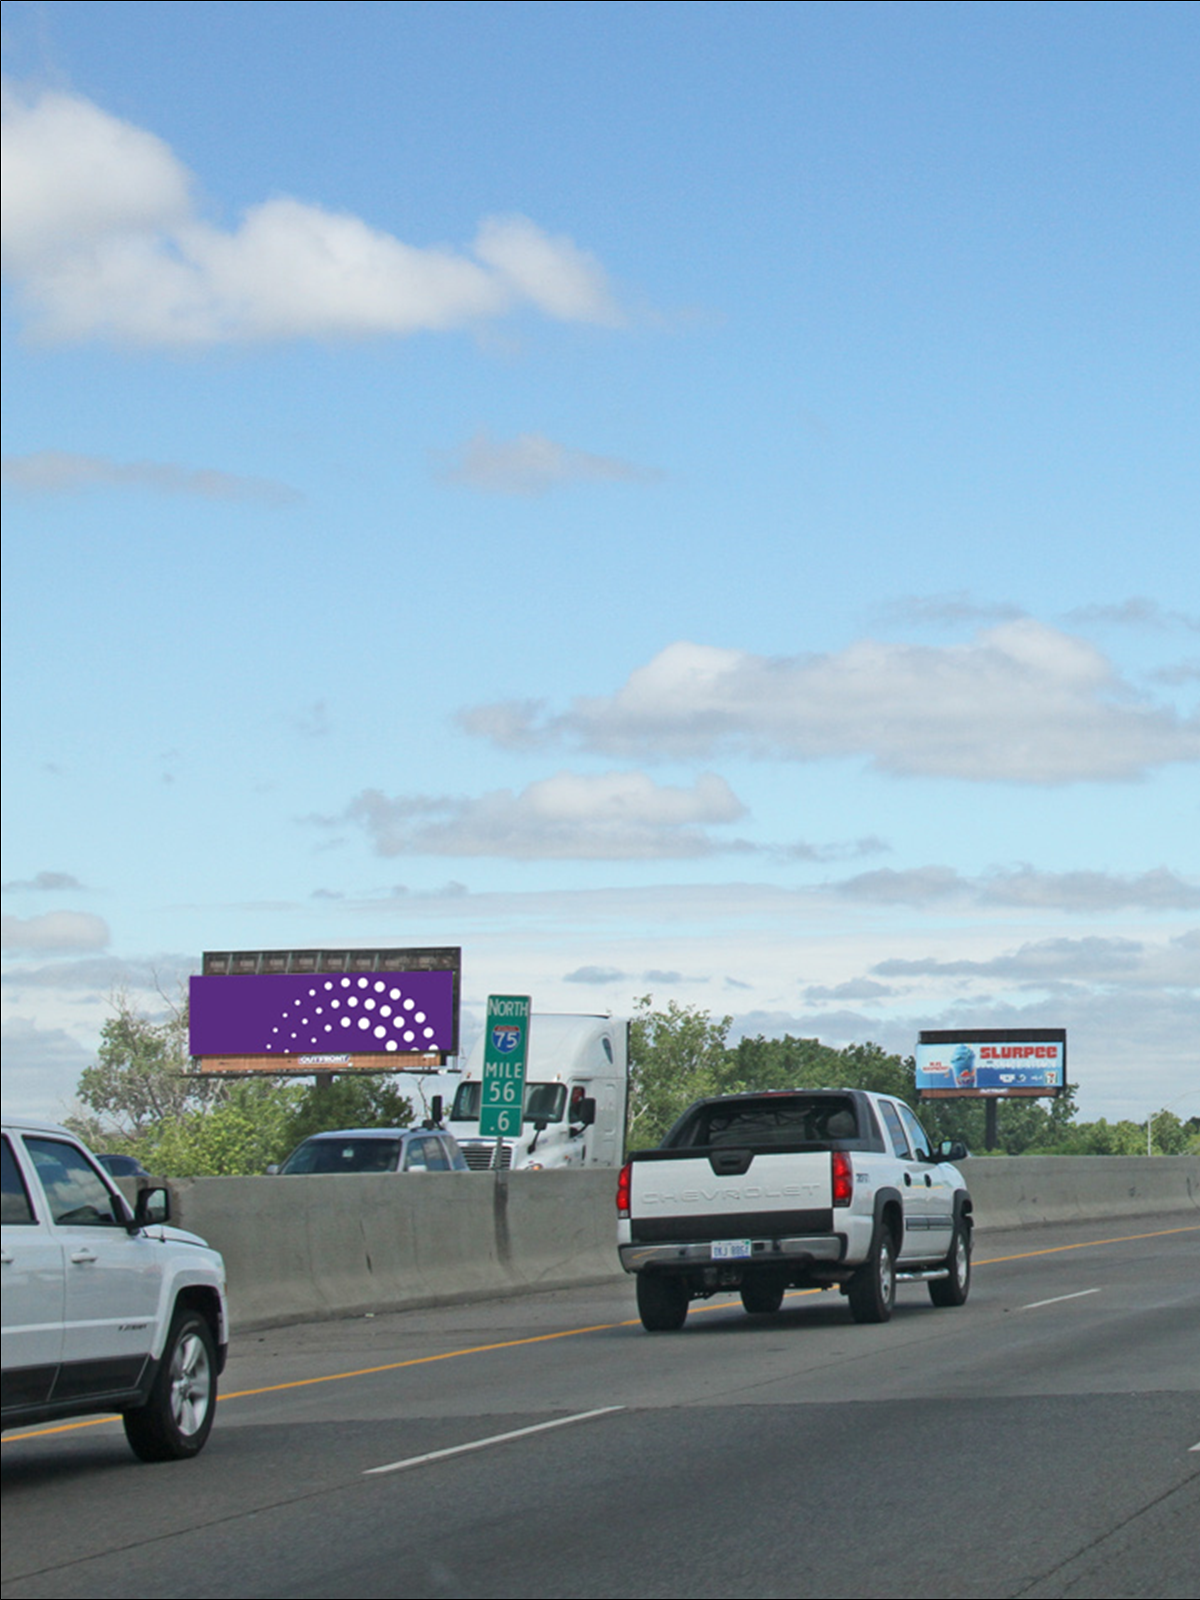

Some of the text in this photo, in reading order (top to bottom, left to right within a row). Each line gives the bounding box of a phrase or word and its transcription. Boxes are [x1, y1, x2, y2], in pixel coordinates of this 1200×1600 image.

[488, 998, 529, 1016] NORTH
[495, 1032, 518, 1049] 75
[485, 1062, 522, 1078] MILE
[489, 1081, 515, 1102] 56
[489, 1110, 510, 1131] .6
[641, 1185, 820, 1205] CHEVROLET
